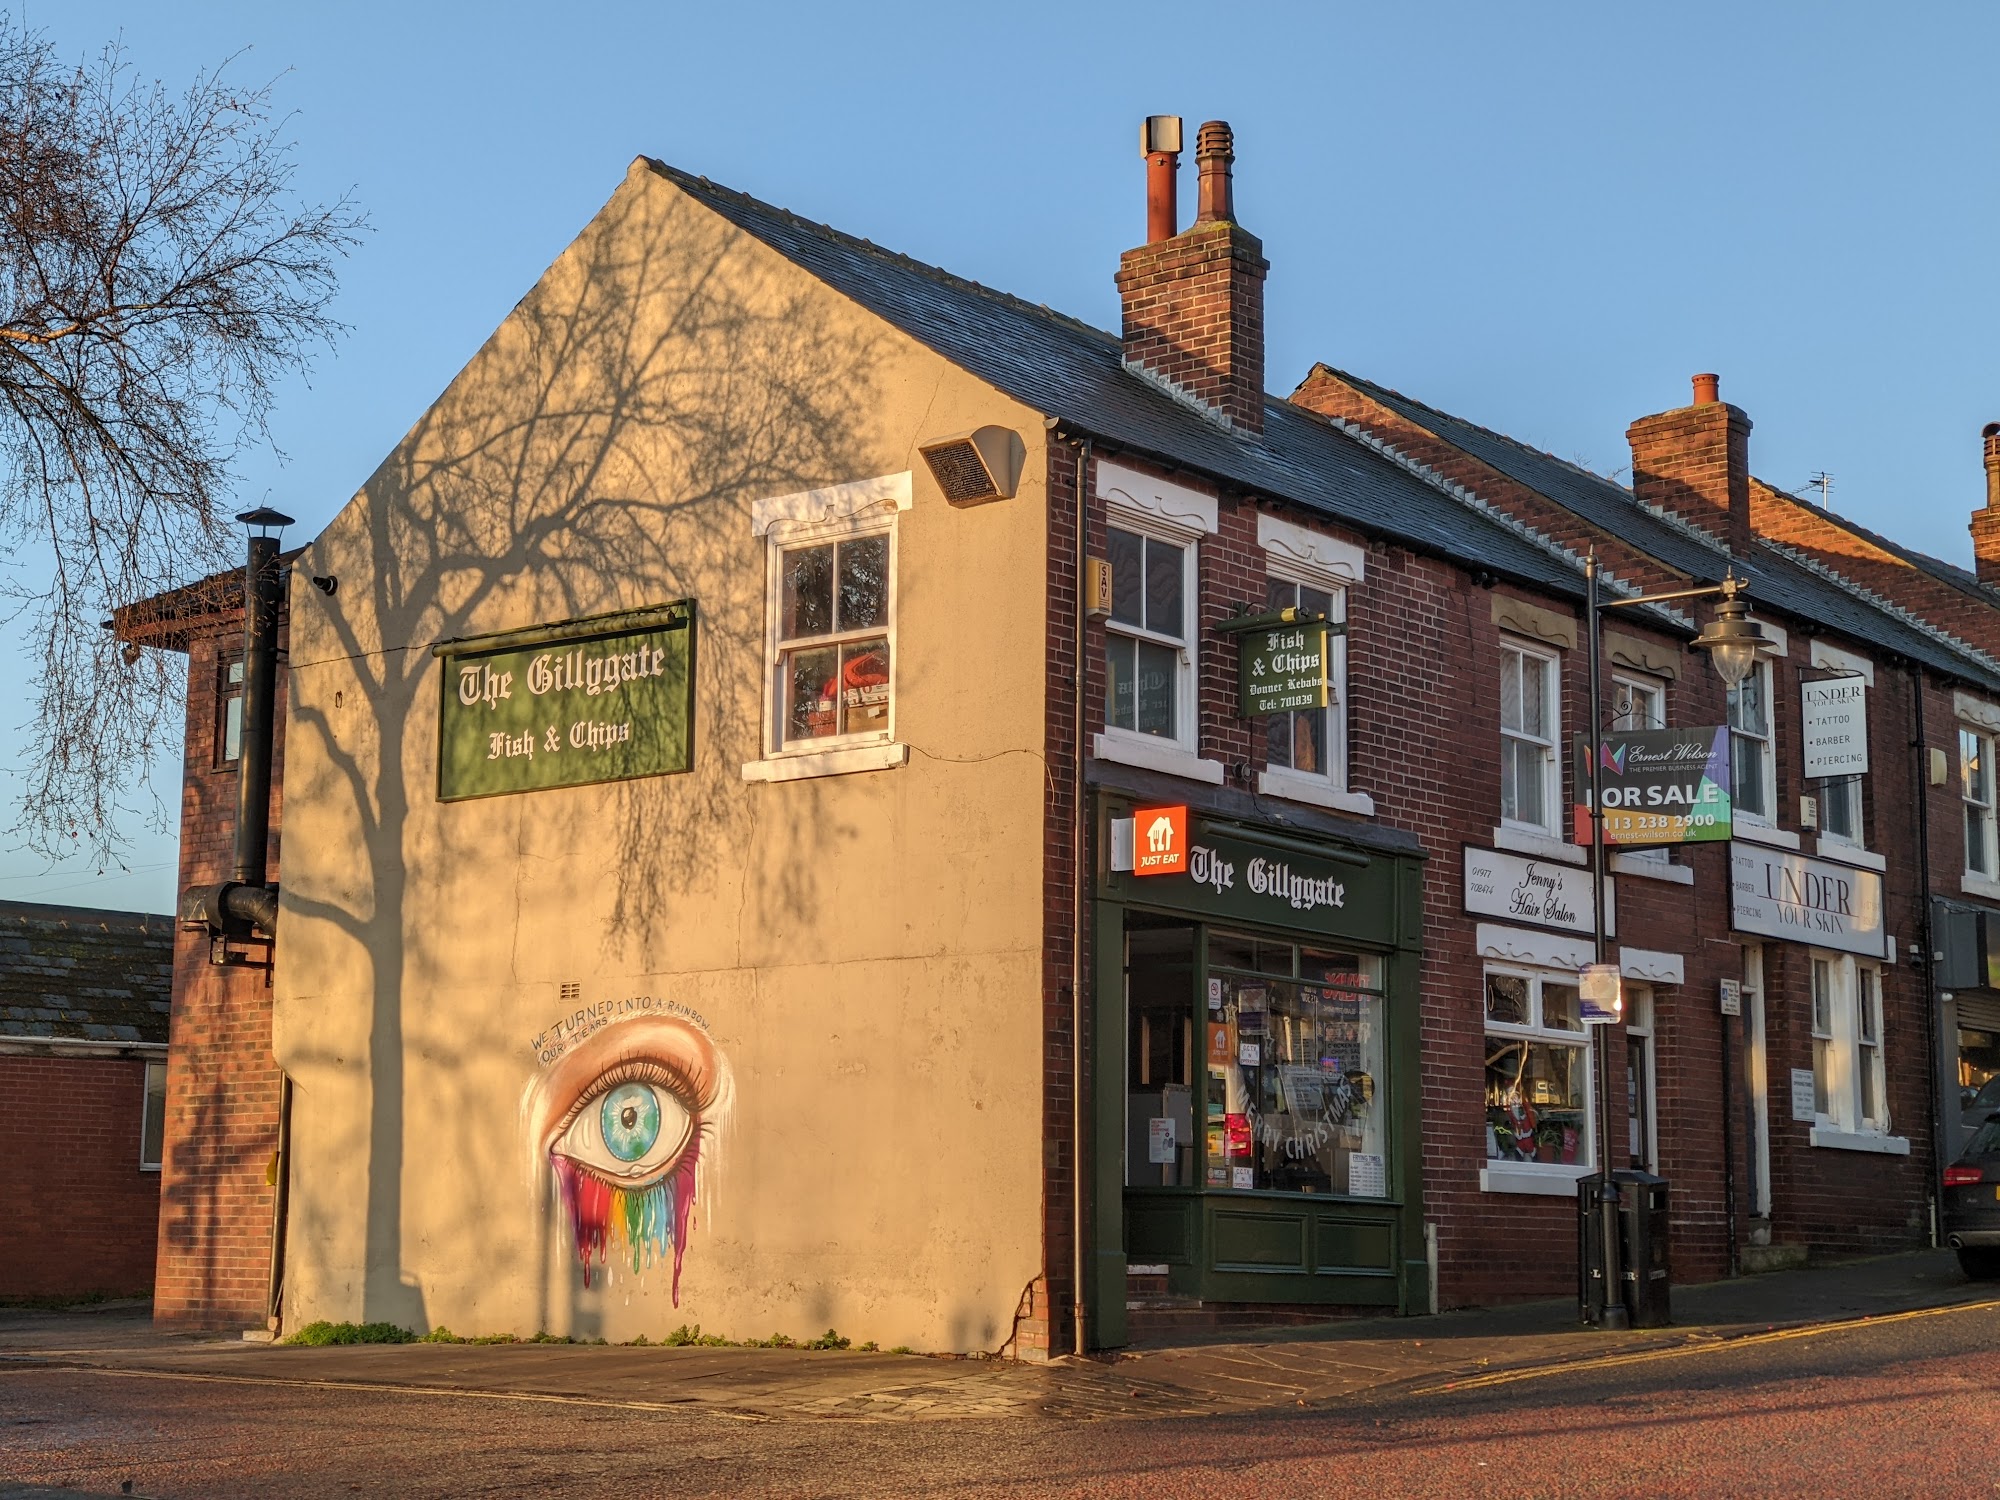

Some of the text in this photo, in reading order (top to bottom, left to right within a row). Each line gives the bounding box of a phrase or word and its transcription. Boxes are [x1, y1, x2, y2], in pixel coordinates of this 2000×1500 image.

[1266, 630, 1304, 651] Fish
[1252, 653, 1320, 676] & Chips
[458, 643, 666, 710] The Gillygate
[1249, 676, 1323, 695] Donner Kebabs
[1259, 694, 1313, 711] Tel: 701839
[1807, 686, 1861, 701] UNDER
[1816, 715, 1850, 726] TATTOO
[487, 720, 629, 760] Fish & Chips
[1816, 735, 1850, 746] BARBER
[1629, 743, 1717, 763] Ernest Wilson
[1817, 754, 1862, 765] PIERCING
[1647, 784, 1719, 806] SALE
[1638, 817, 1668, 829] 238
[1674, 814, 1715, 828] 2900
[1611, 829, 1696, 840] ernest-wilson.co.uk
[1141, 854, 1180, 867] JUST EAT
[1735, 856, 1754, 868] TATTOO
[1190, 845, 1345, 910] The Gillygate
[1472, 867, 1492, 878] 01977
[1519, 861, 1563, 898] Jenny's
[1735, 881, 1755, 893] BARBER
[1765, 863, 1851, 915] UNDER
[1509, 887, 1541, 917] Hair
[1543, 897, 1576, 923] Salon
[1736, 905, 1761, 919] PIERCING
[1777, 903, 1812, 929] YOUR
[1816, 912, 1843, 934] SKIN
[531, 996, 710, 1051] WE TURNED INTO A RAINBOW
[541, 1016, 608, 1063] OUR TEARS
[1237, 1075, 1351, 1160] MERRY CHRISTMAS
